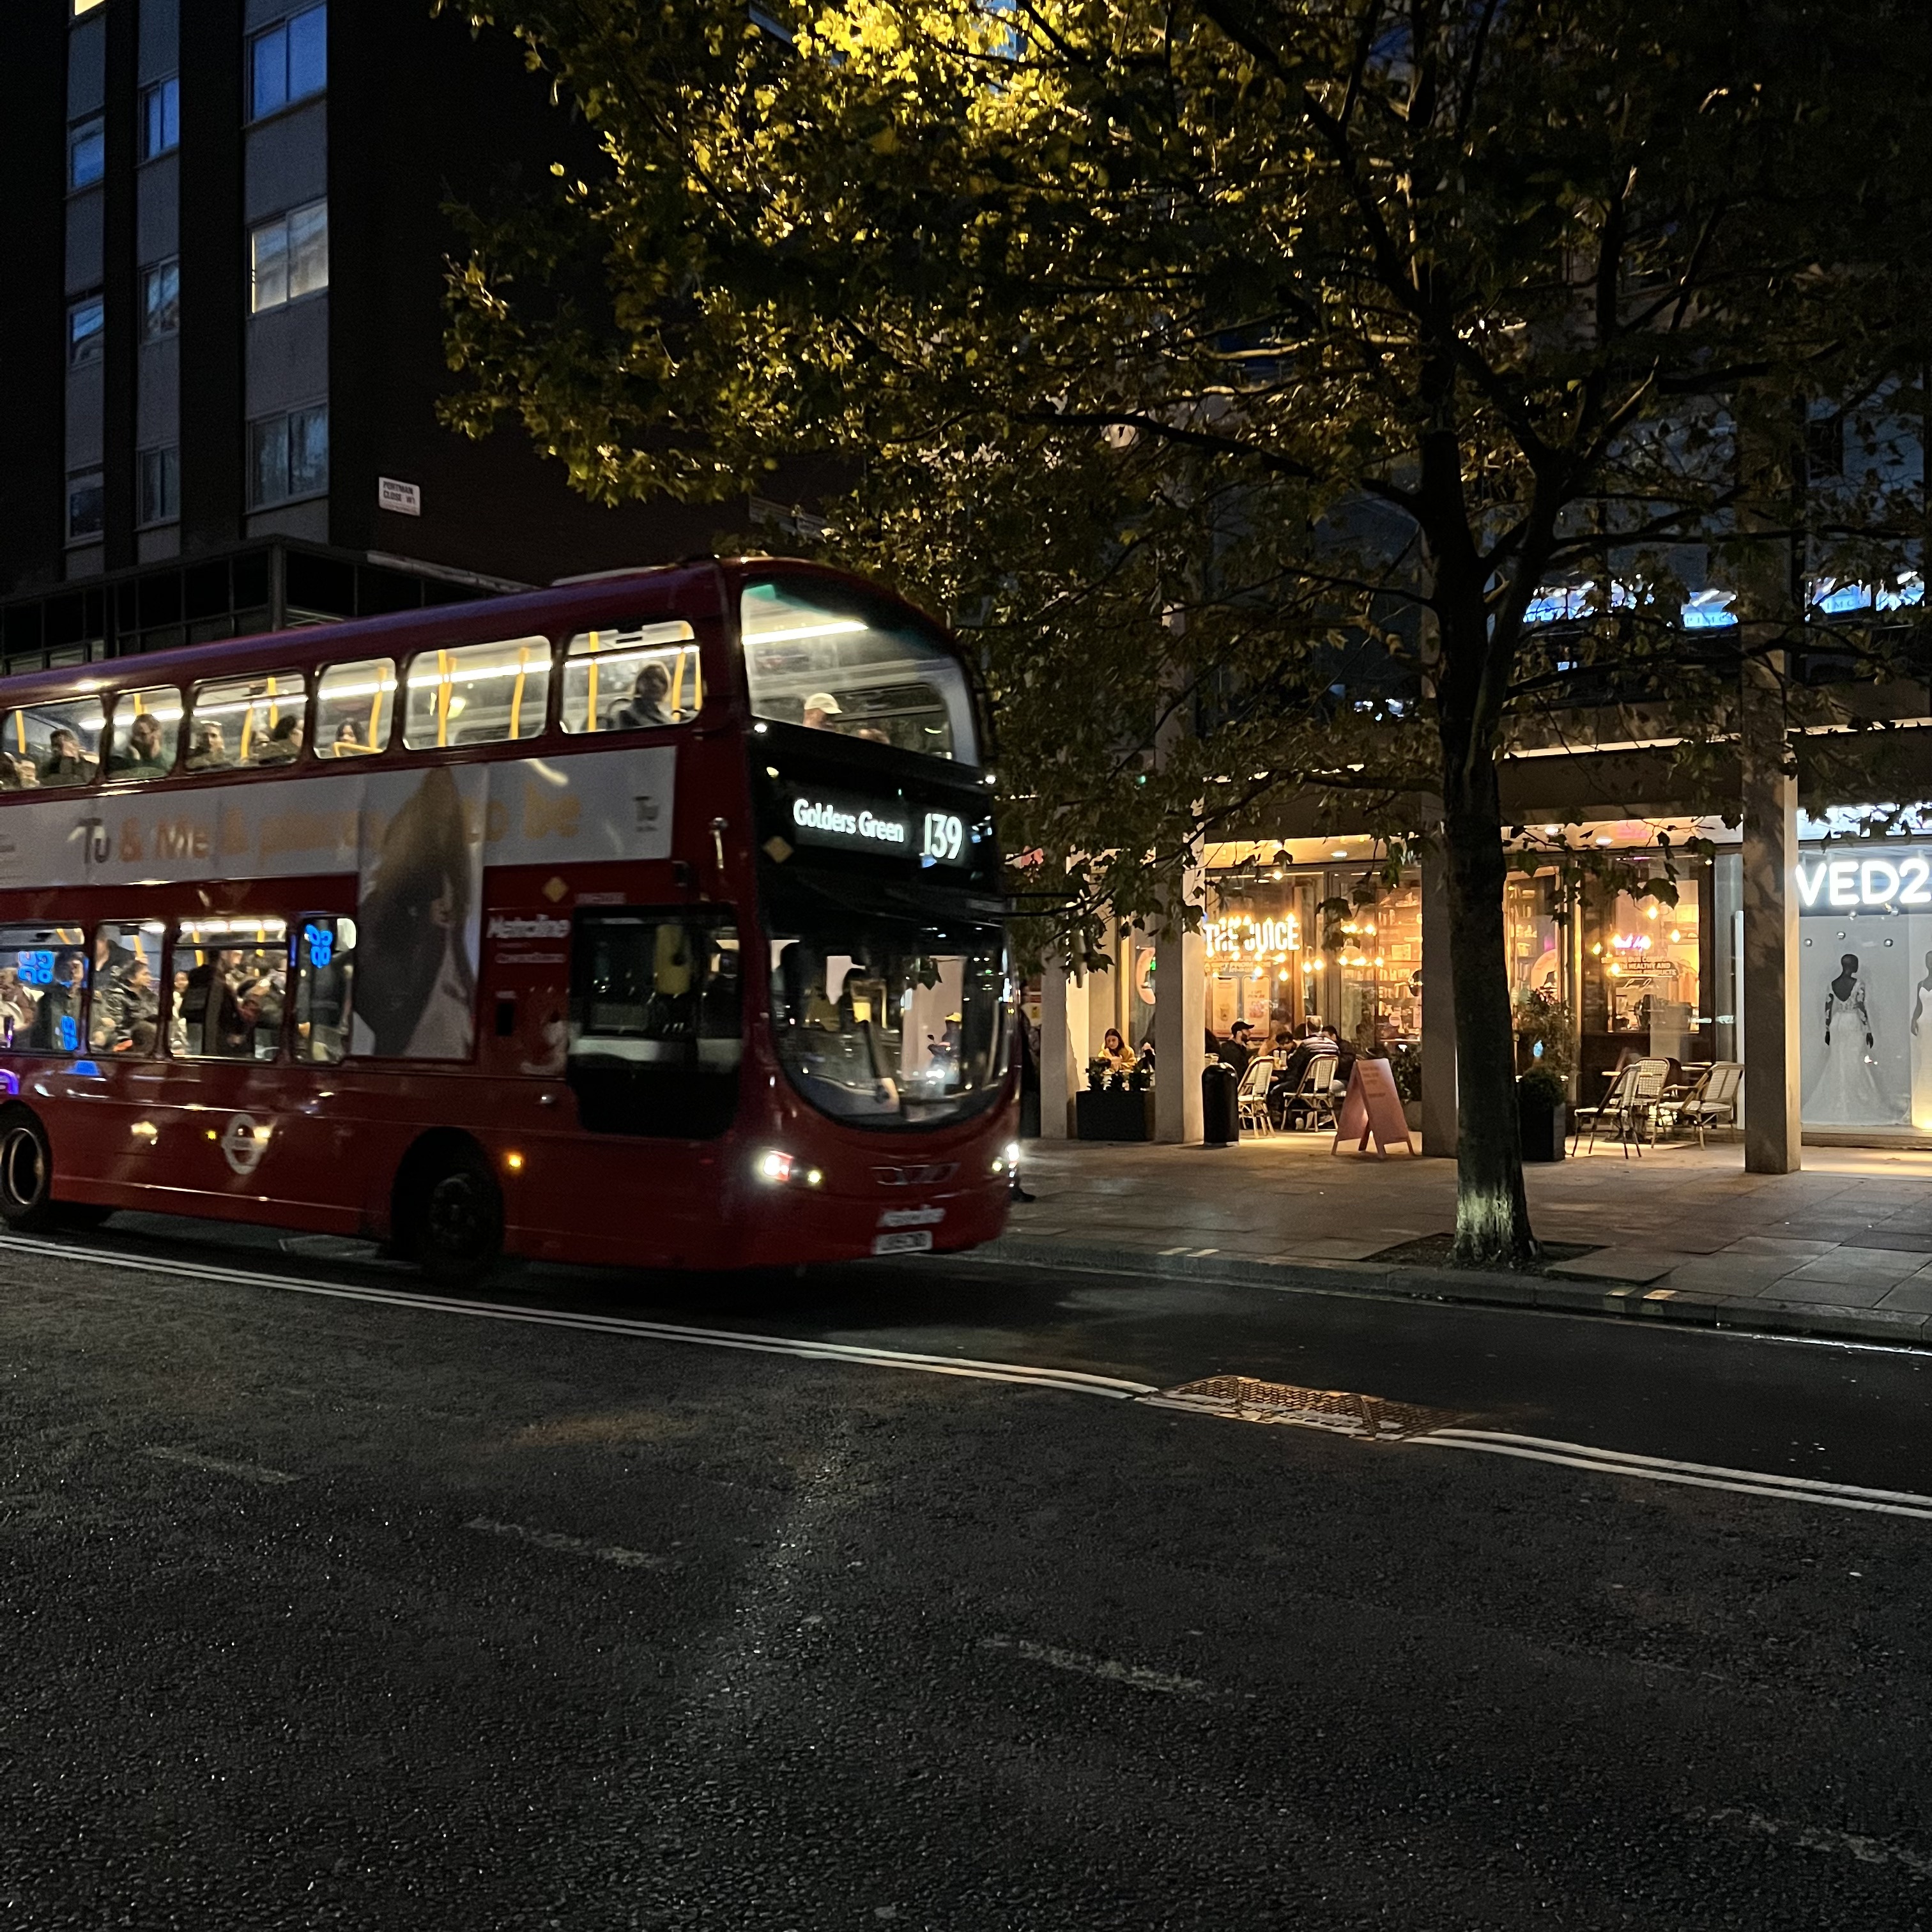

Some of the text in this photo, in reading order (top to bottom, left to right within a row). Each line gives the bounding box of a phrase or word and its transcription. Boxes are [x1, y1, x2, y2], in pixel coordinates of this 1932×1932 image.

[383, 481, 413, 495] PORTMAN
[383, 490, 401, 502] CLOSE
[793, 799, 963, 859] Golders Green 139
[1202, 921, 1301, 953] THE JUICE
